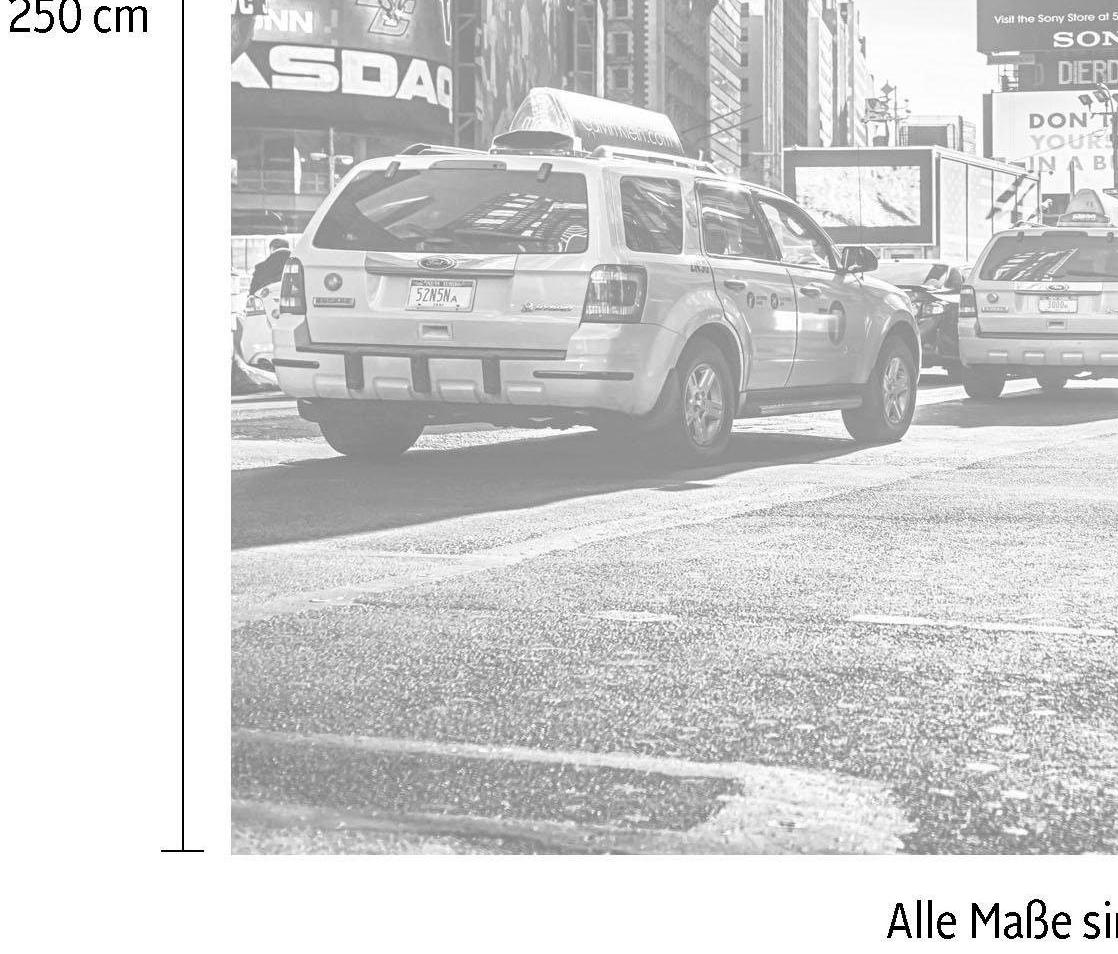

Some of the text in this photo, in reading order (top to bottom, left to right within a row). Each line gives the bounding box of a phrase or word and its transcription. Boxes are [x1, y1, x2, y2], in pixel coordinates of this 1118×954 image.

[994, 14, 1015, 25] Visit
[1018, 13, 1035, 24] the
[1037, 12, 1064, 26] Sony
[1067, 12, 1095, 23] Store
[1098, 12, 1109, 22] at
